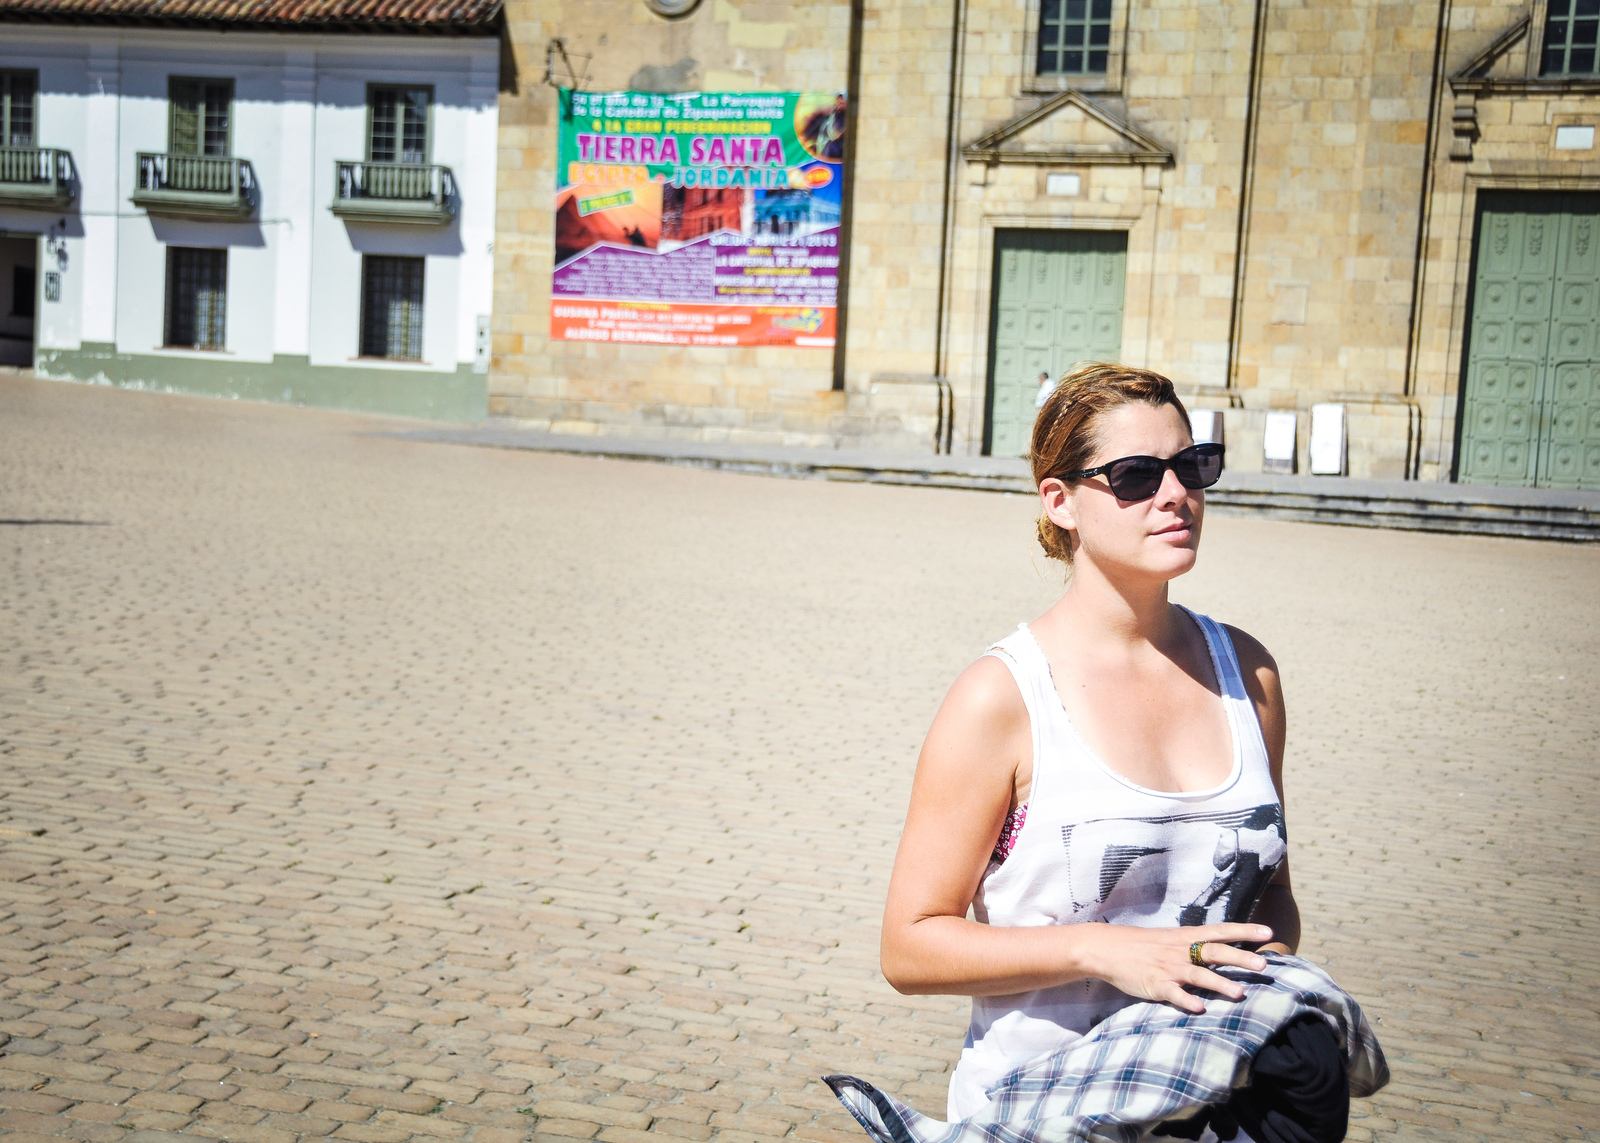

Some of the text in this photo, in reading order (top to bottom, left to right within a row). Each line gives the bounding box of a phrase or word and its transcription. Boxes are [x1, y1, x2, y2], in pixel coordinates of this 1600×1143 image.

[721, 95, 785, 109] Parroquia
[605, 106, 660, 118] Catedral
[662, 108, 680, 118] de
[605, 120, 622, 132] LA
[577, 134, 785, 166] TIERRA SANTA
[569, 162, 650, 183] EGIPTO
[674, 166, 788, 189] JORDANIA
